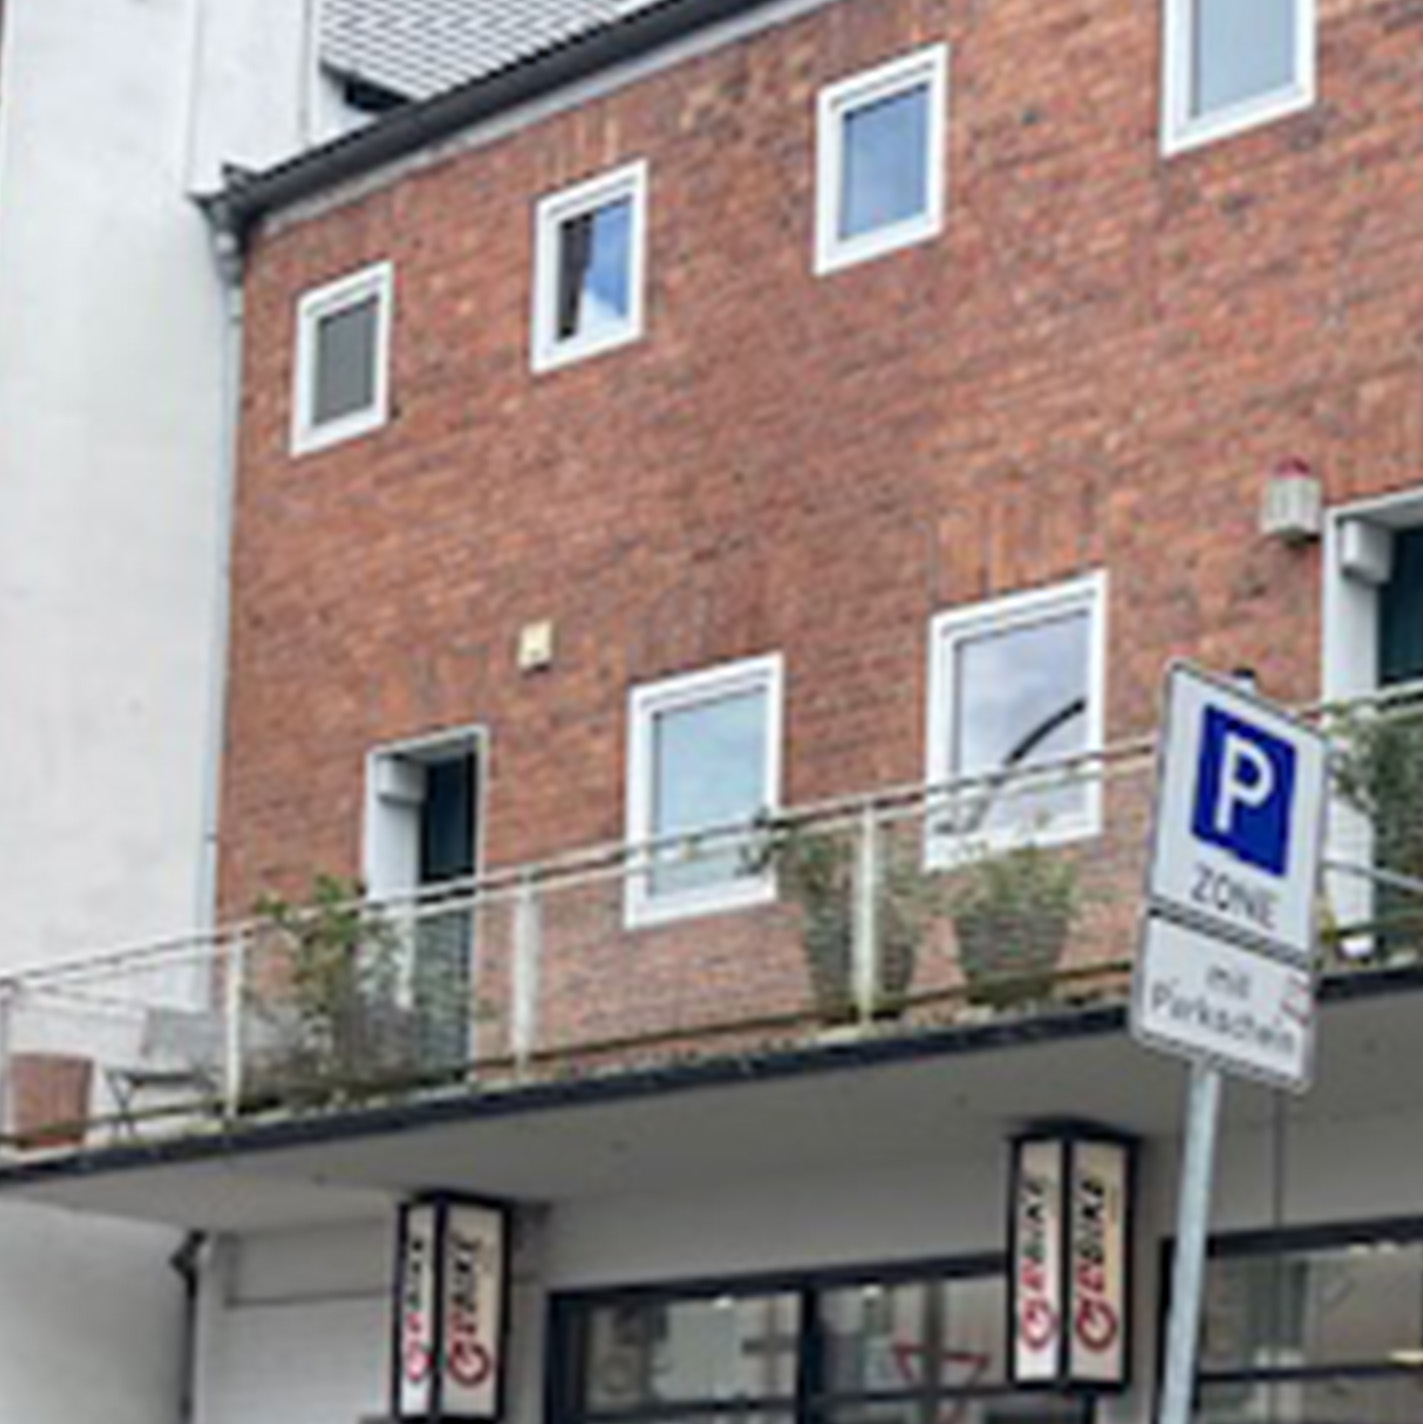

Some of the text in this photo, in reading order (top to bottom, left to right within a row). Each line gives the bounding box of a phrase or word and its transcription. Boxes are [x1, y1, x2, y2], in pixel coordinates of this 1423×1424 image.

[1214, 731, 1276, 834] P
[1189, 863, 1279, 930] ZONE
[1150, 975, 1297, 1056] Parkschein
[1205, 963, 1252, 998] mit
